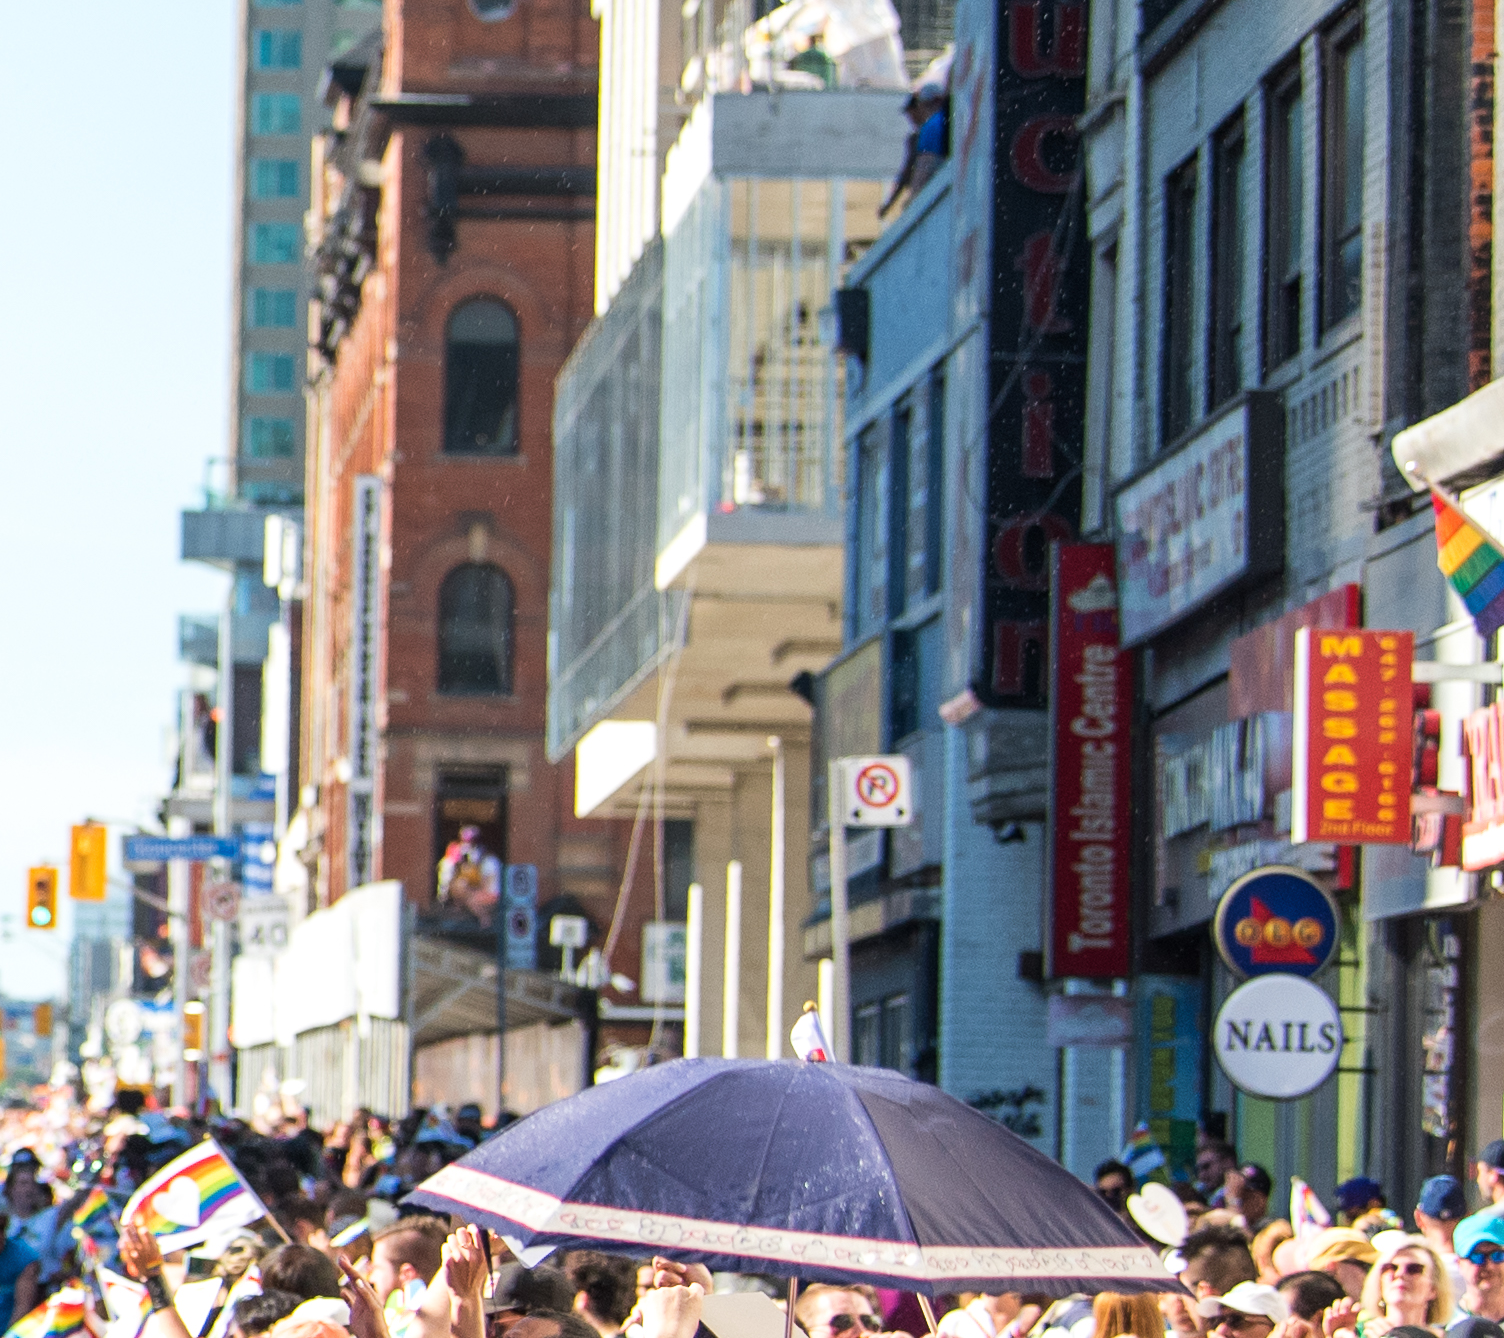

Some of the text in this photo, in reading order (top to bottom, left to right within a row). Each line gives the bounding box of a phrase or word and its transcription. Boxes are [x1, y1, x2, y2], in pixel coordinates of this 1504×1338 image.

[1069, 643, 1119, 954] Toronto Islamic Centre
[1321, 635, 1363, 821] MASSAGE
[1224, 1019, 1338, 1054] NAILS
